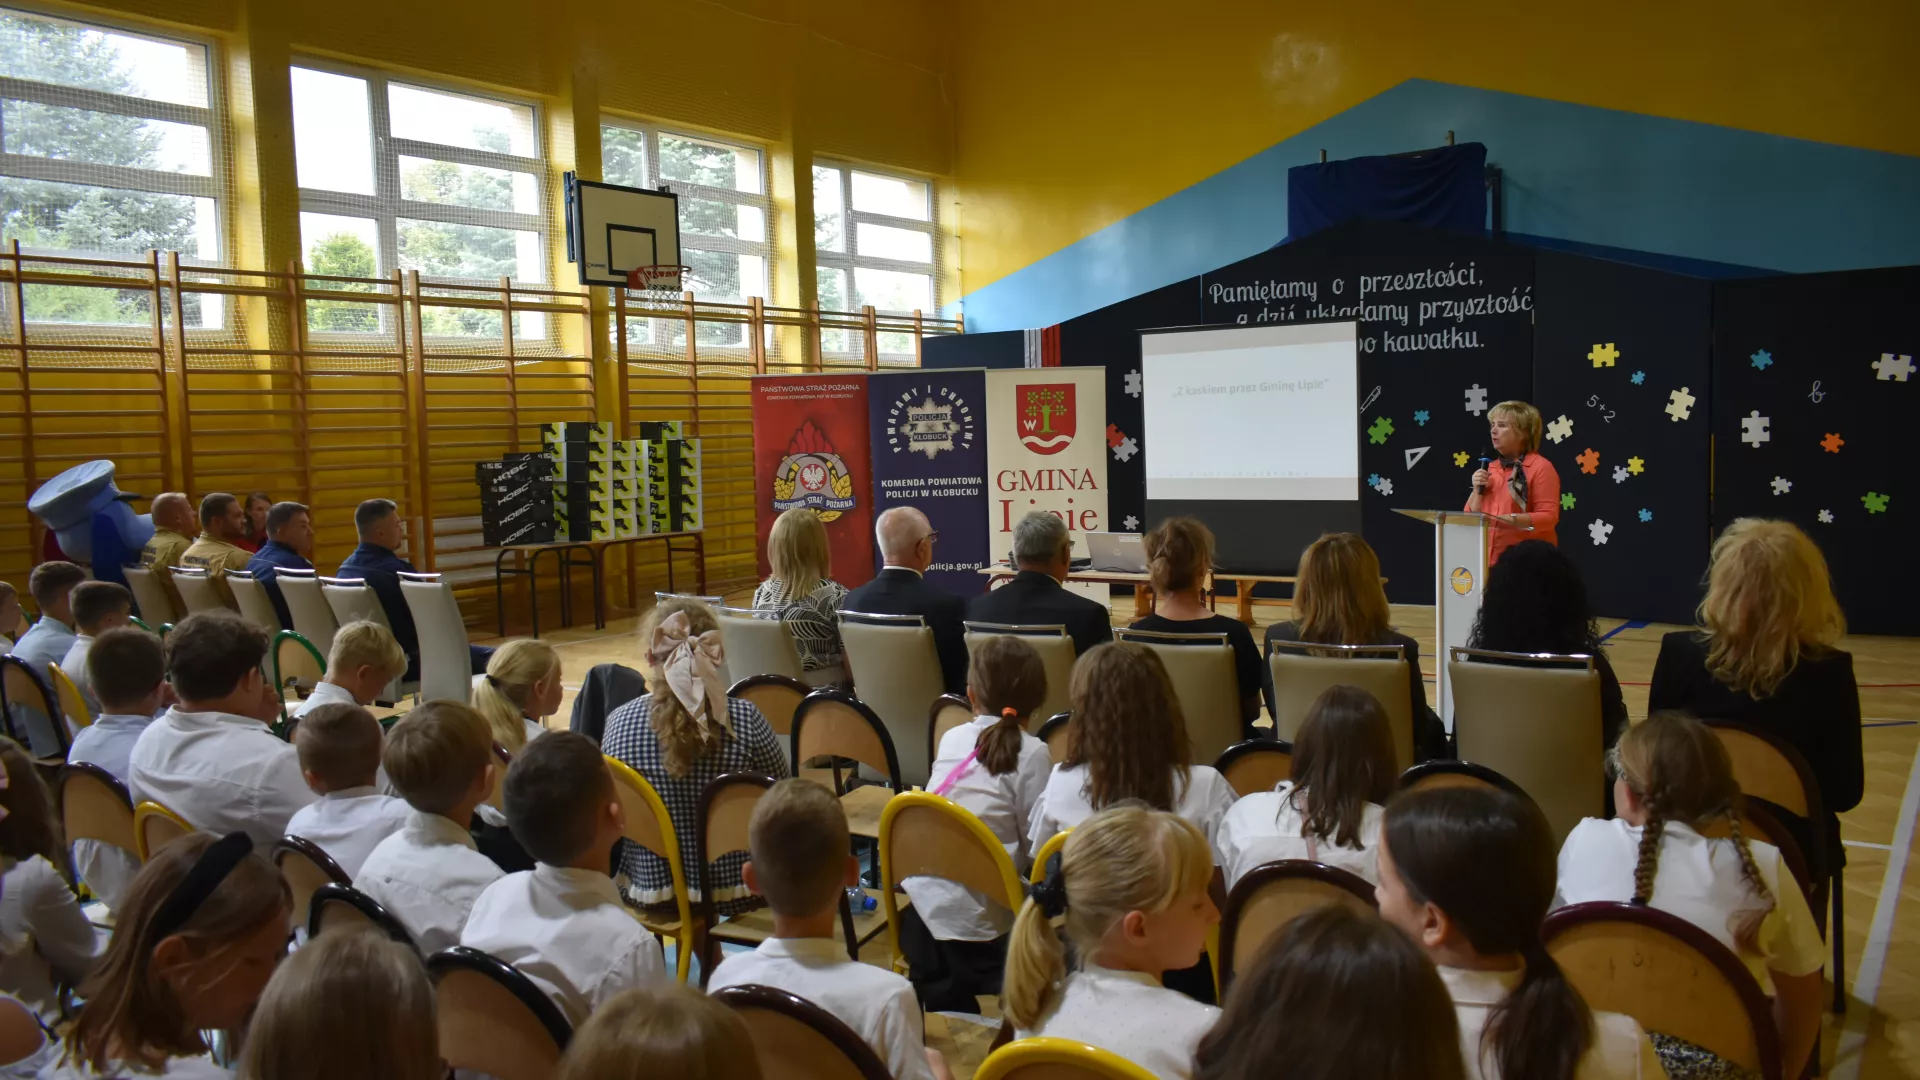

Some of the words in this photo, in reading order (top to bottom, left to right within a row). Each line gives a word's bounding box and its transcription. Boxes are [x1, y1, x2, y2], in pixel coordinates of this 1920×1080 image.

[1209, 279, 1317, 304] Pamiętamy
[1332, 278, 1345, 295] o
[1360, 262, 1484, 300] przeszłości,
[1419, 287, 1534, 326] przyszłość
[1384, 327, 1485, 353] kawałku.
[761, 385, 805, 393] PAŃSTWOWA
[806, 384, 827, 392] STRAŻ
[1186, 384, 1227, 396] kaskiem
[1229, 384, 1257, 396] przez
[1259, 381, 1295, 393] Gminę
[887, 388, 918, 453] POMAGAMY
[927, 385, 931, 393] I
[940, 388, 974, 449] CHRONIMY
[1024, 419, 1037, 431] W
[881, 478, 925, 488] KOMENDA
[928, 477, 982, 486] POWIATOWA
[997, 468, 1098, 492] GMINA
[886, 490, 918, 498] POLICJI
[921, 489, 930, 497] W
[932, 488, 979, 497] KŁOBUCKU
[826, 500, 853, 508] POŻARNA
